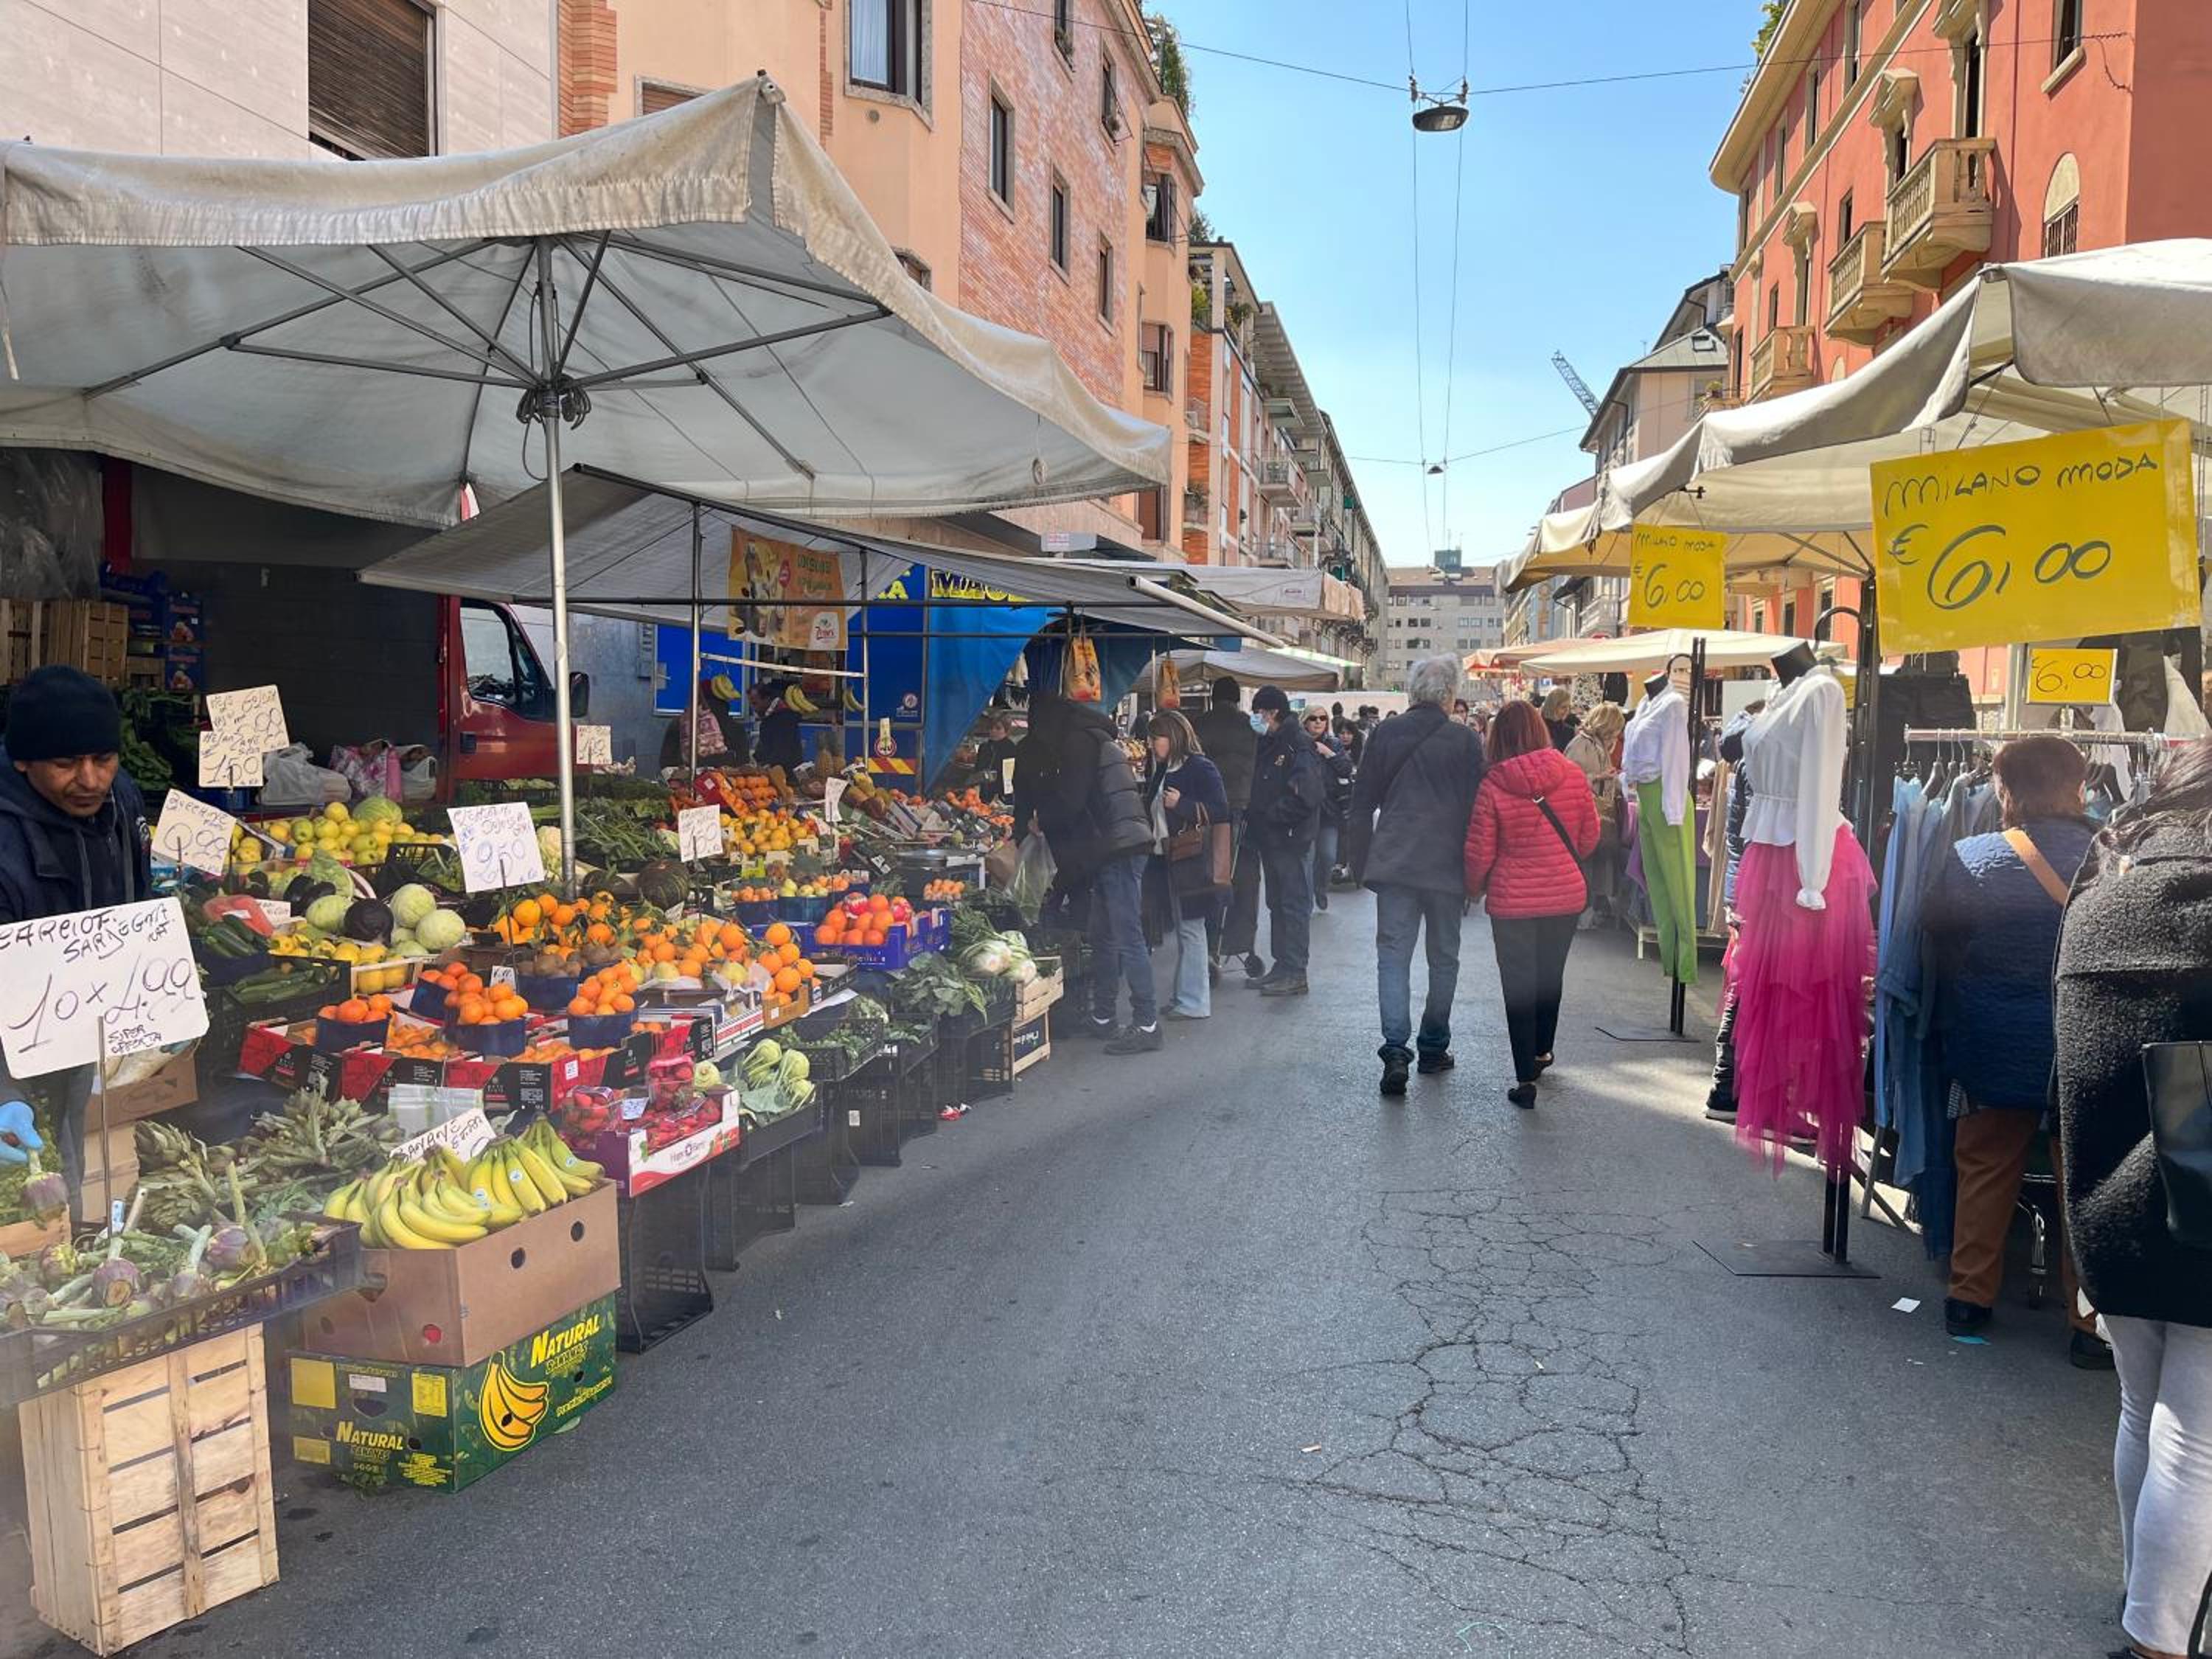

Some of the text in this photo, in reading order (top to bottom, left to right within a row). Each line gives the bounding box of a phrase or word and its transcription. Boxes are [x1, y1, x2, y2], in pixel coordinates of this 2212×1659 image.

[1885, 452, 2157, 518] MILANO MODA
[8, 973, 80, 1053] 10
[531, 1314, 600, 1369] NATURAL
[335, 1420, 404, 1450] NATURAL
